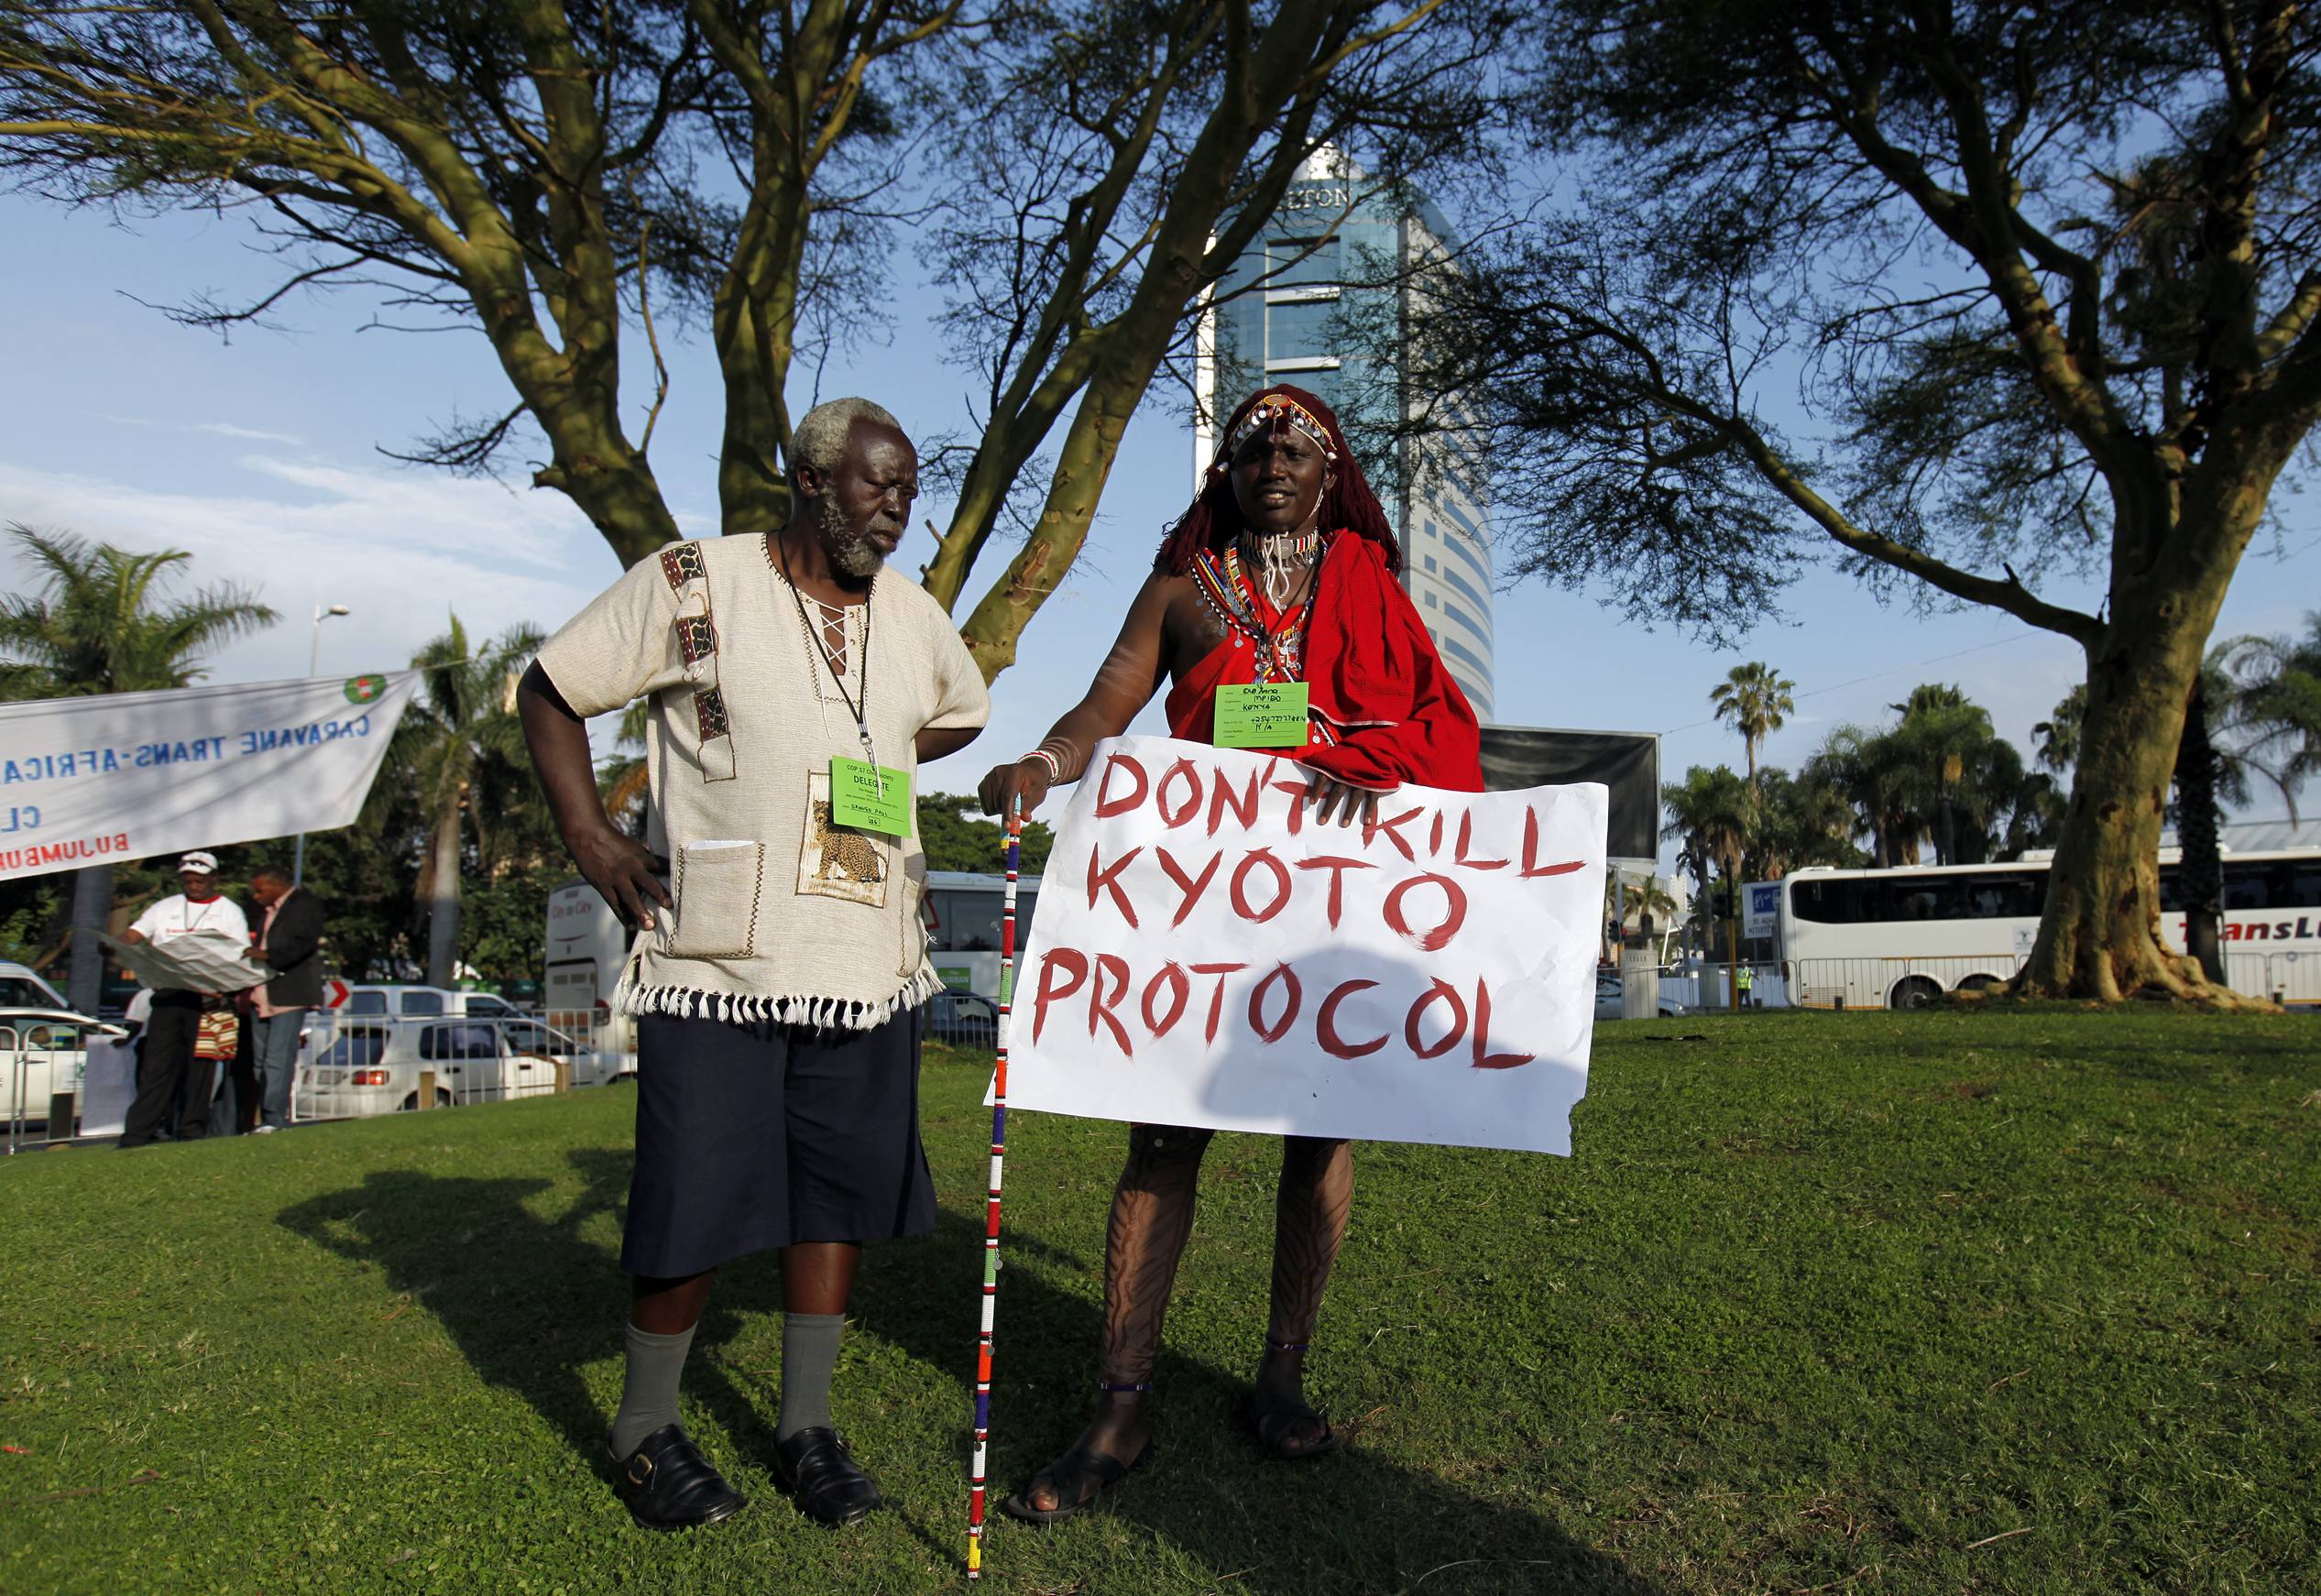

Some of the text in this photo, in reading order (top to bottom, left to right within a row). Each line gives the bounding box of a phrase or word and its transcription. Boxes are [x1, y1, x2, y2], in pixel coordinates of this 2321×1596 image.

[1275, 188, 1354, 210] LTON
[853, 775, 890, 792] DELEGTE
[1094, 751, 1588, 878] DON'T KILL
[1086, 841, 1468, 952] KYOTO
[2179, 917, 2321, 942] ansL
[1032, 946, 1537, 1069] PROTOCOL
